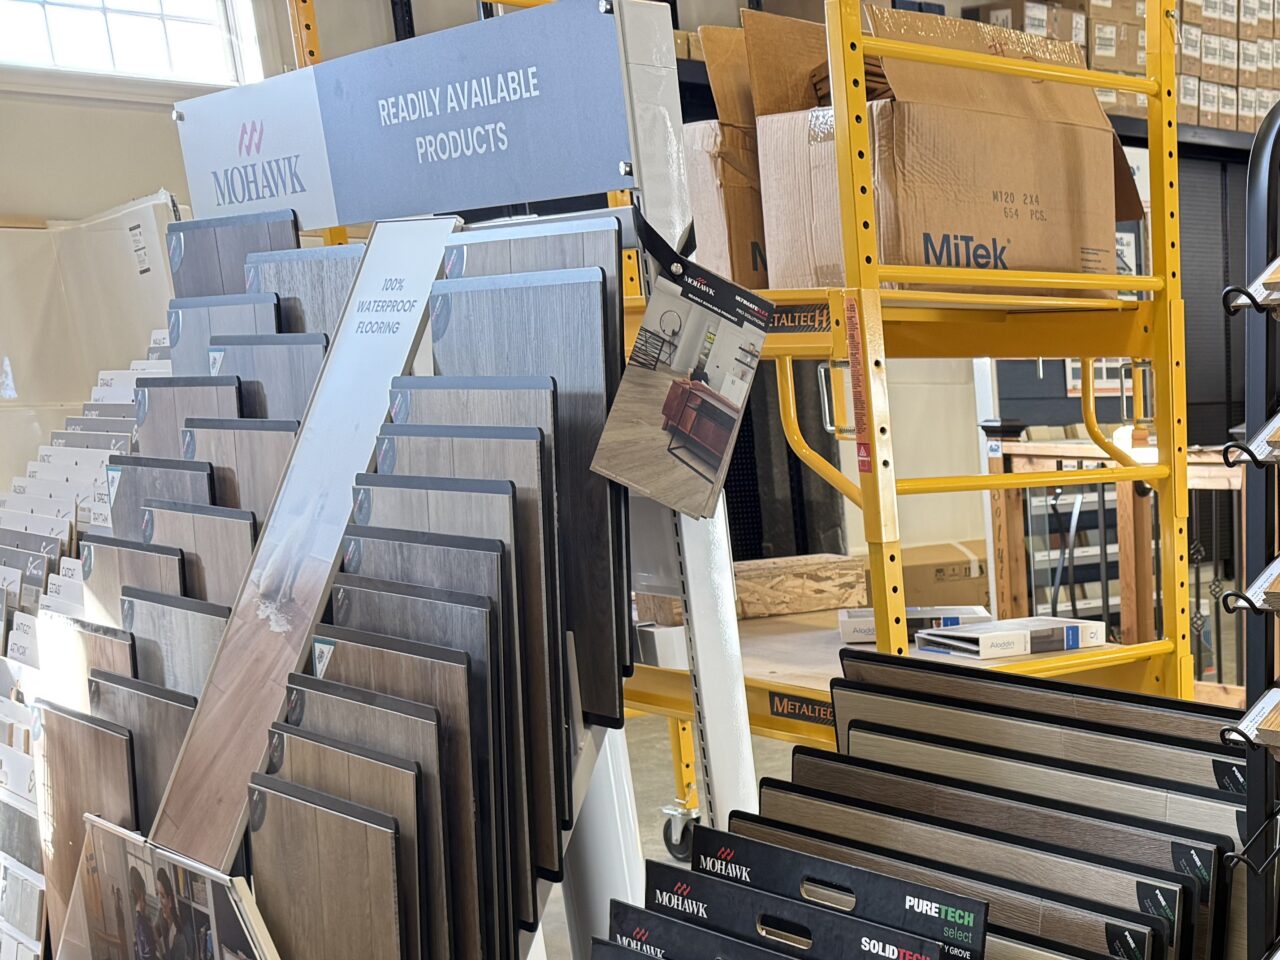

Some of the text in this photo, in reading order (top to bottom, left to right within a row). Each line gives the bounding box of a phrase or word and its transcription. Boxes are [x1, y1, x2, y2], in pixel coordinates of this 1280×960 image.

[378, 66, 540, 126] READILY AVAILABLE
[415, 121, 509, 164] PRODUCTS
[210, 154, 307, 206] MOHAWK
[1023, 193, 1040, 206] 2X4
[1003, 207, 1019, 219] 654
[922, 232, 1008, 269] MiTek
[382, 278, 406, 291] 100%
[683, 275, 716, 297] MOHAWK
[356, 300, 418, 313] WATERPROOF
[355, 321, 400, 334] FLOORING
[769, 308, 828, 328] TALTECH
[852, 626, 876, 635] Aladd
[990, 640, 1015, 650] Aladdin
[774, 696, 834, 720] METALTEC
[699, 855, 751, 882] MOHAWK
[655, 889, 708, 919] MOHAWK
[905, 895, 974, 928] PURETECH
[943, 926, 972, 944] select
[616, 933, 665, 959] MOHAWK
[949, 946, 971, 960] GROVE
